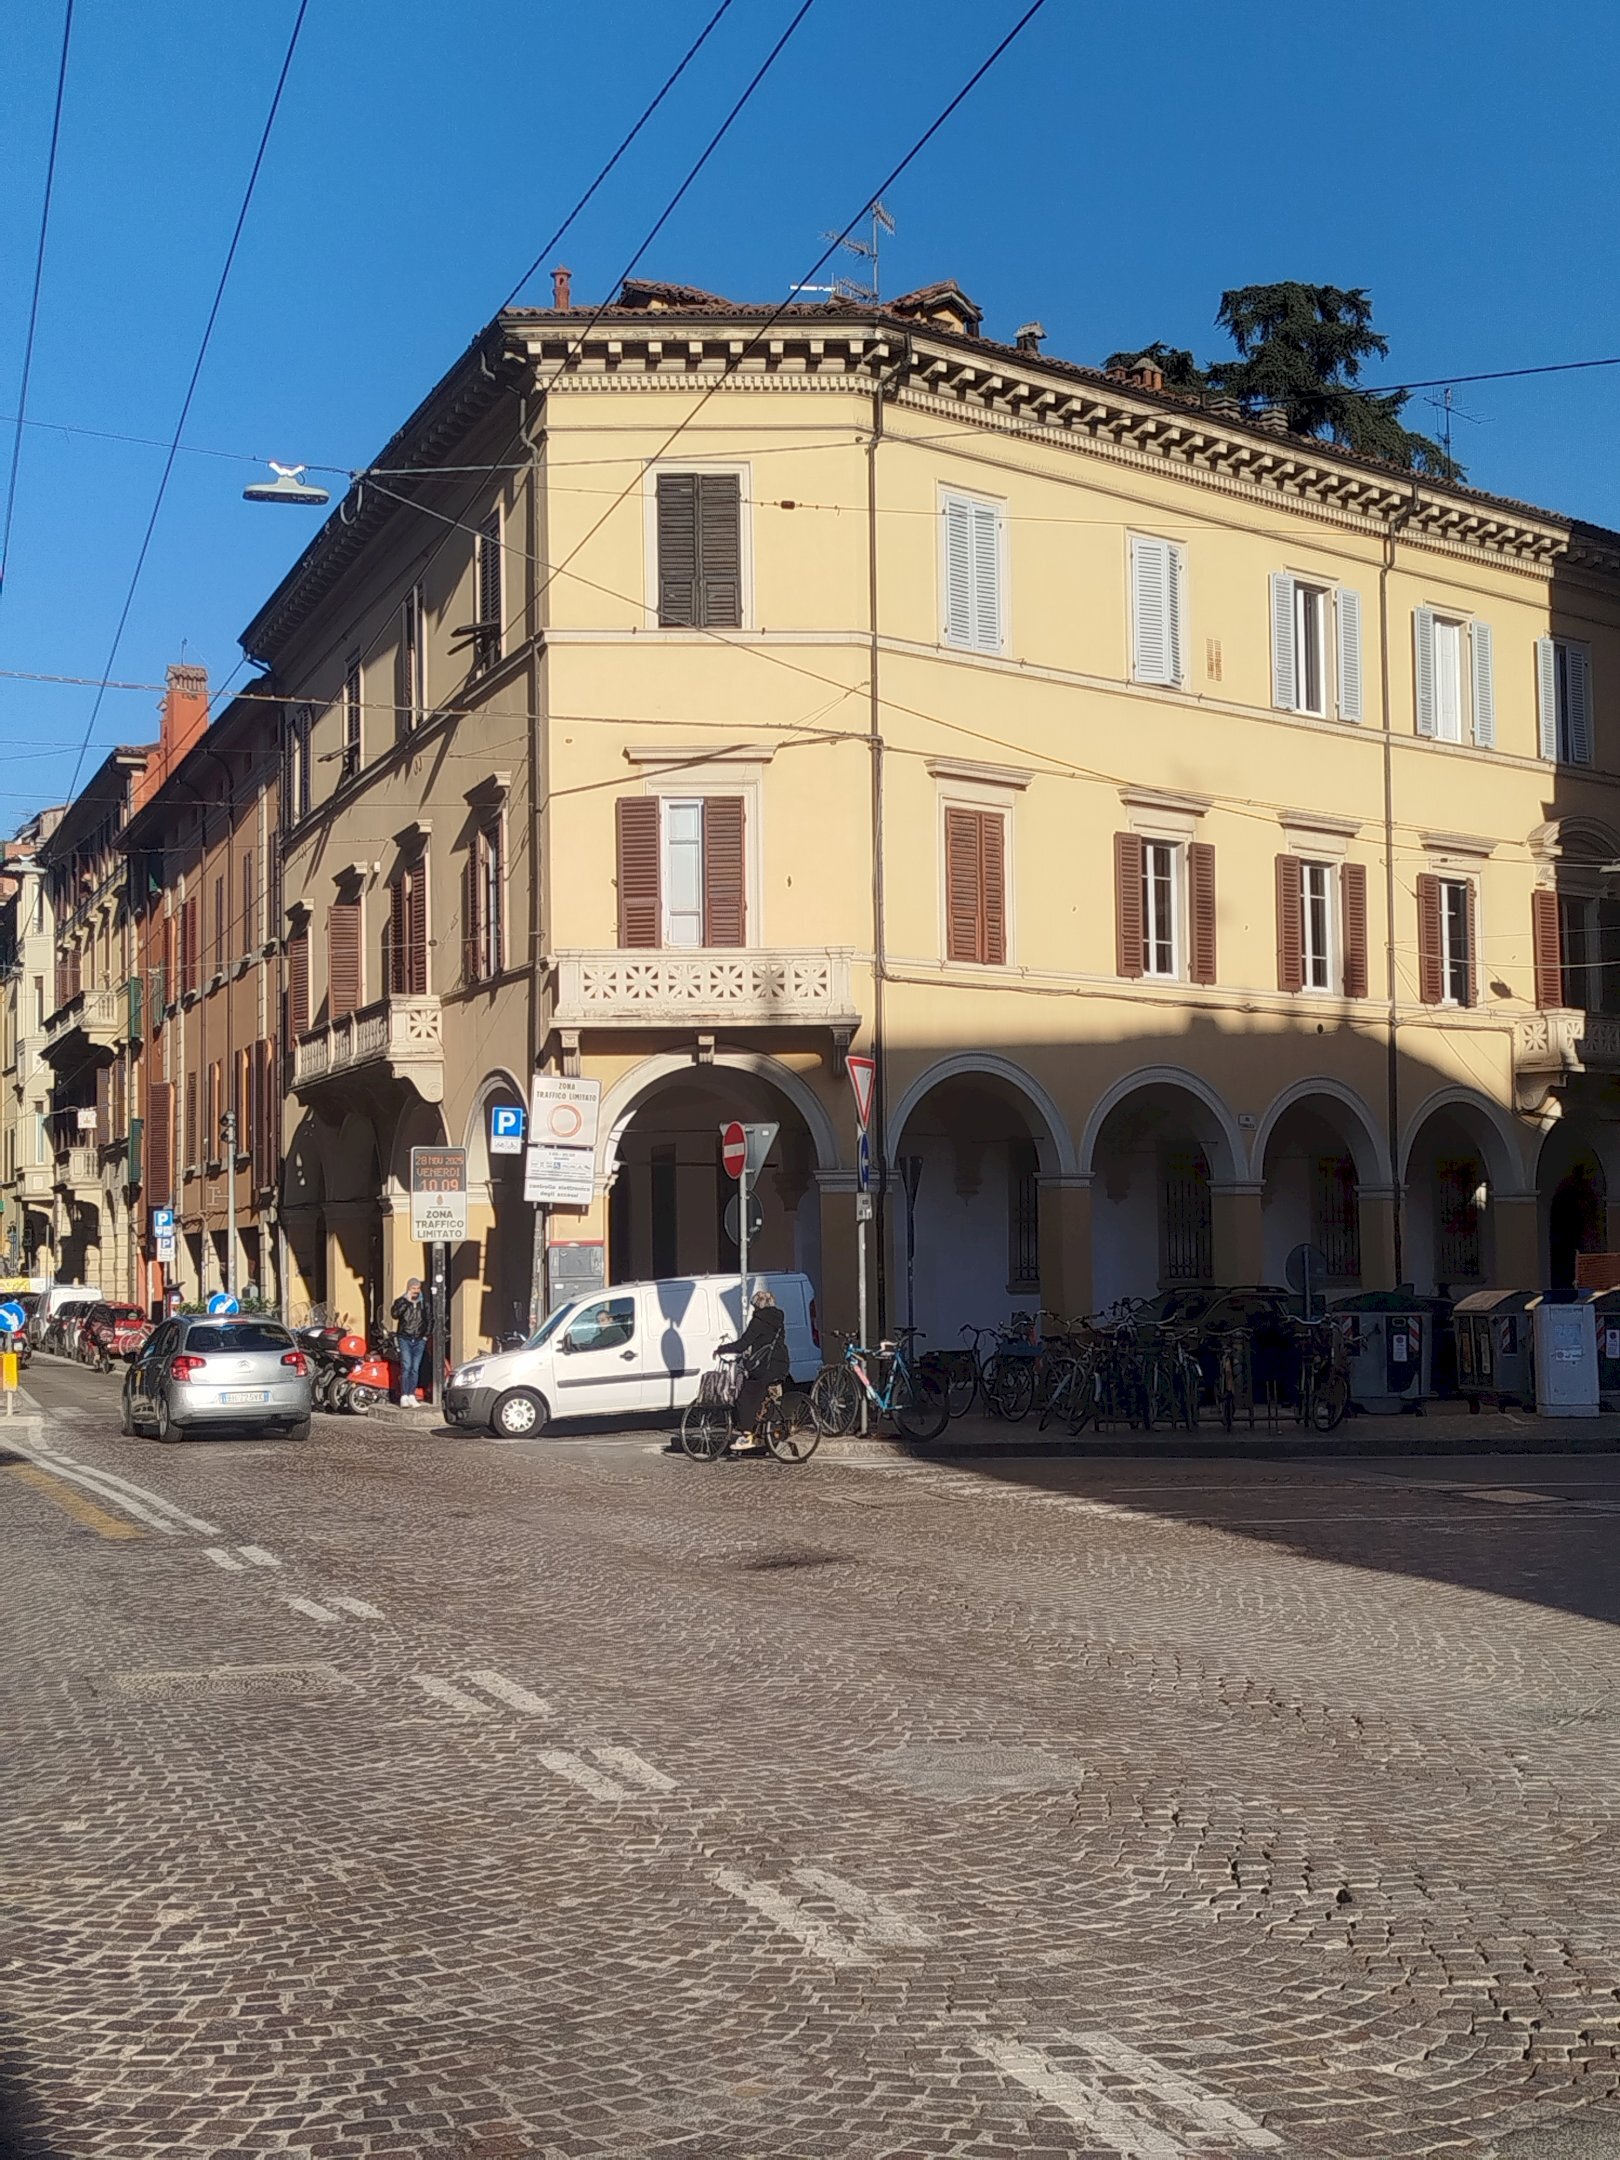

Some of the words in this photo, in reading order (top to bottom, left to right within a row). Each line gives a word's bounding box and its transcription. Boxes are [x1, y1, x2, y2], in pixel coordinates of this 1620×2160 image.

[558, 1082, 576, 1091] ZONA
[536, 1091, 567, 1100] TRAFFICO
[568, 1093, 597, 1102] LIMITATO
[498, 1111, 516, 1134] P
[415, 1155, 428, 1166] 28
[157, 1213, 168, 1226] P
[425, 1210, 453, 1219] ZONA
[415, 1220, 465, 1229] TRAFFICO
[417, 1229, 462, 1239] LIMITATO
